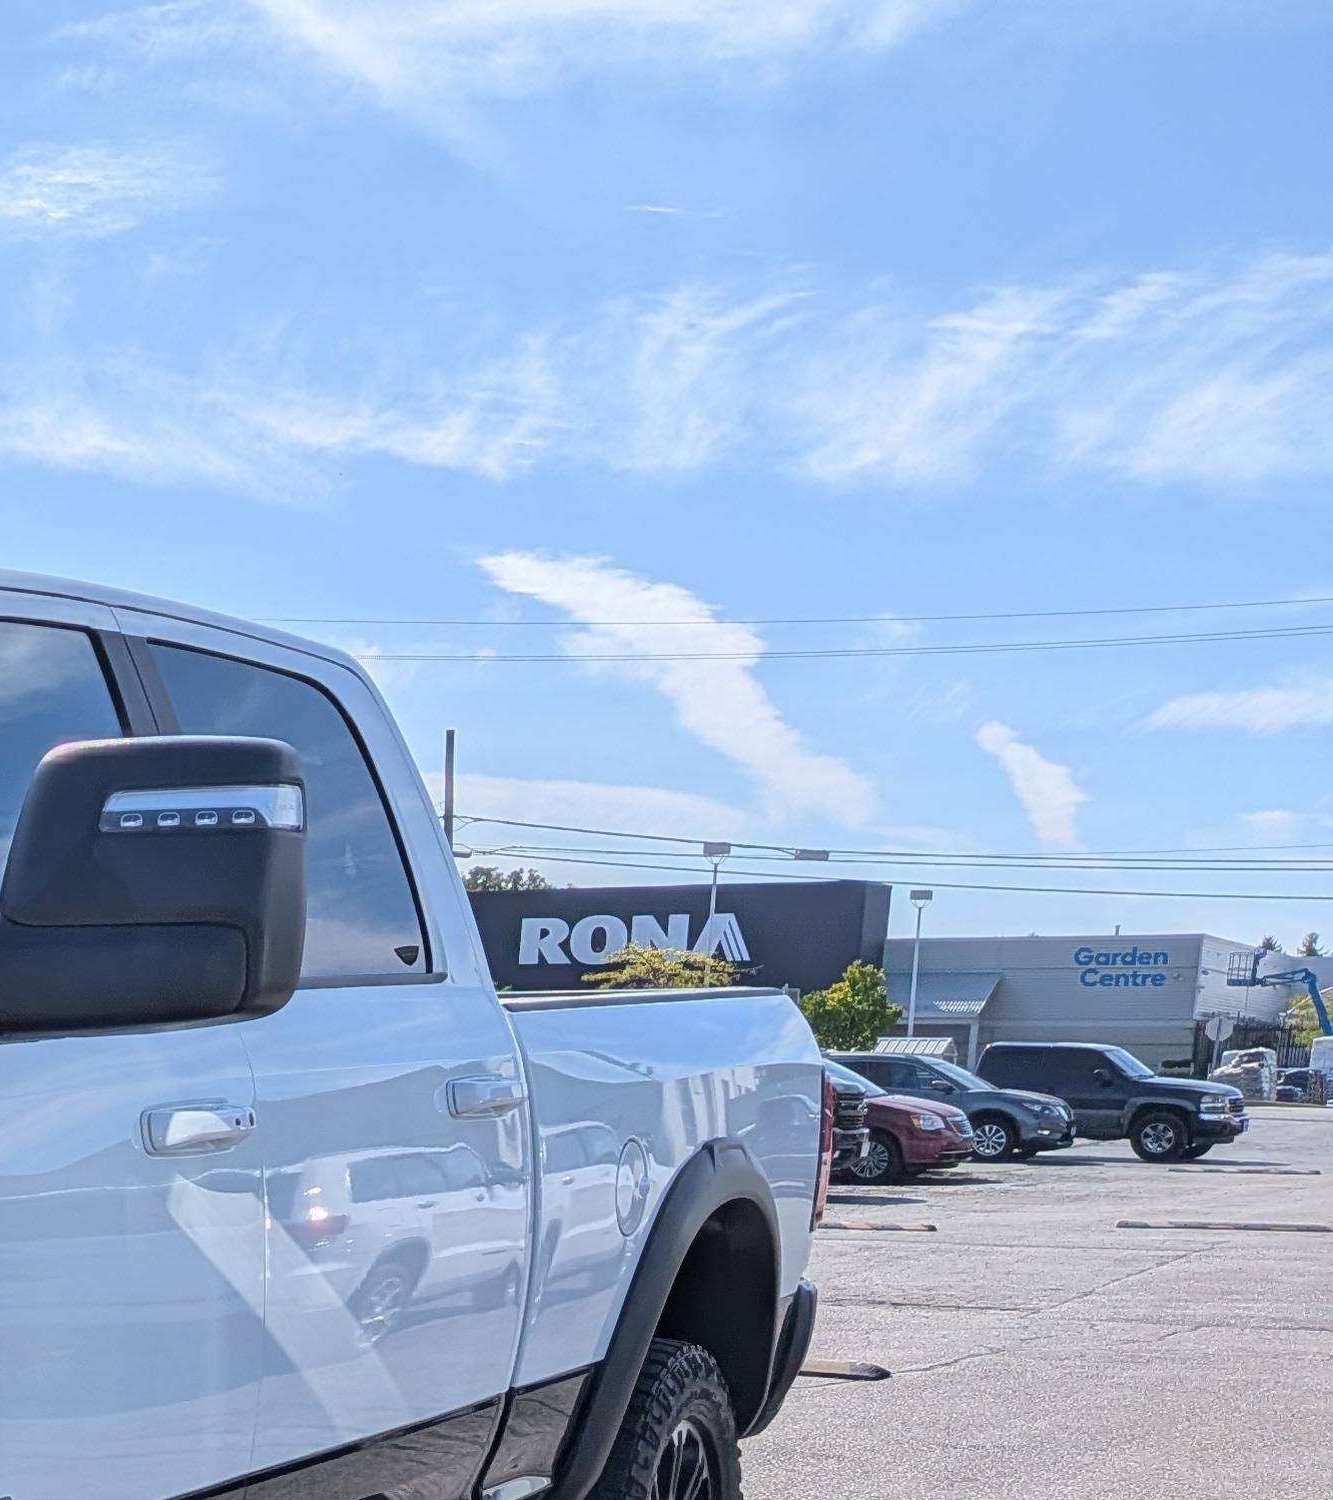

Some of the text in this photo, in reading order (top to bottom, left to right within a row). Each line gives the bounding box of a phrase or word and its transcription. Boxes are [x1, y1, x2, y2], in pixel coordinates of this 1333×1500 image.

[519, 914, 751, 965] RONA
[1074, 946, 1169, 966] Garden
[1080, 968, 1166, 987] Centre
